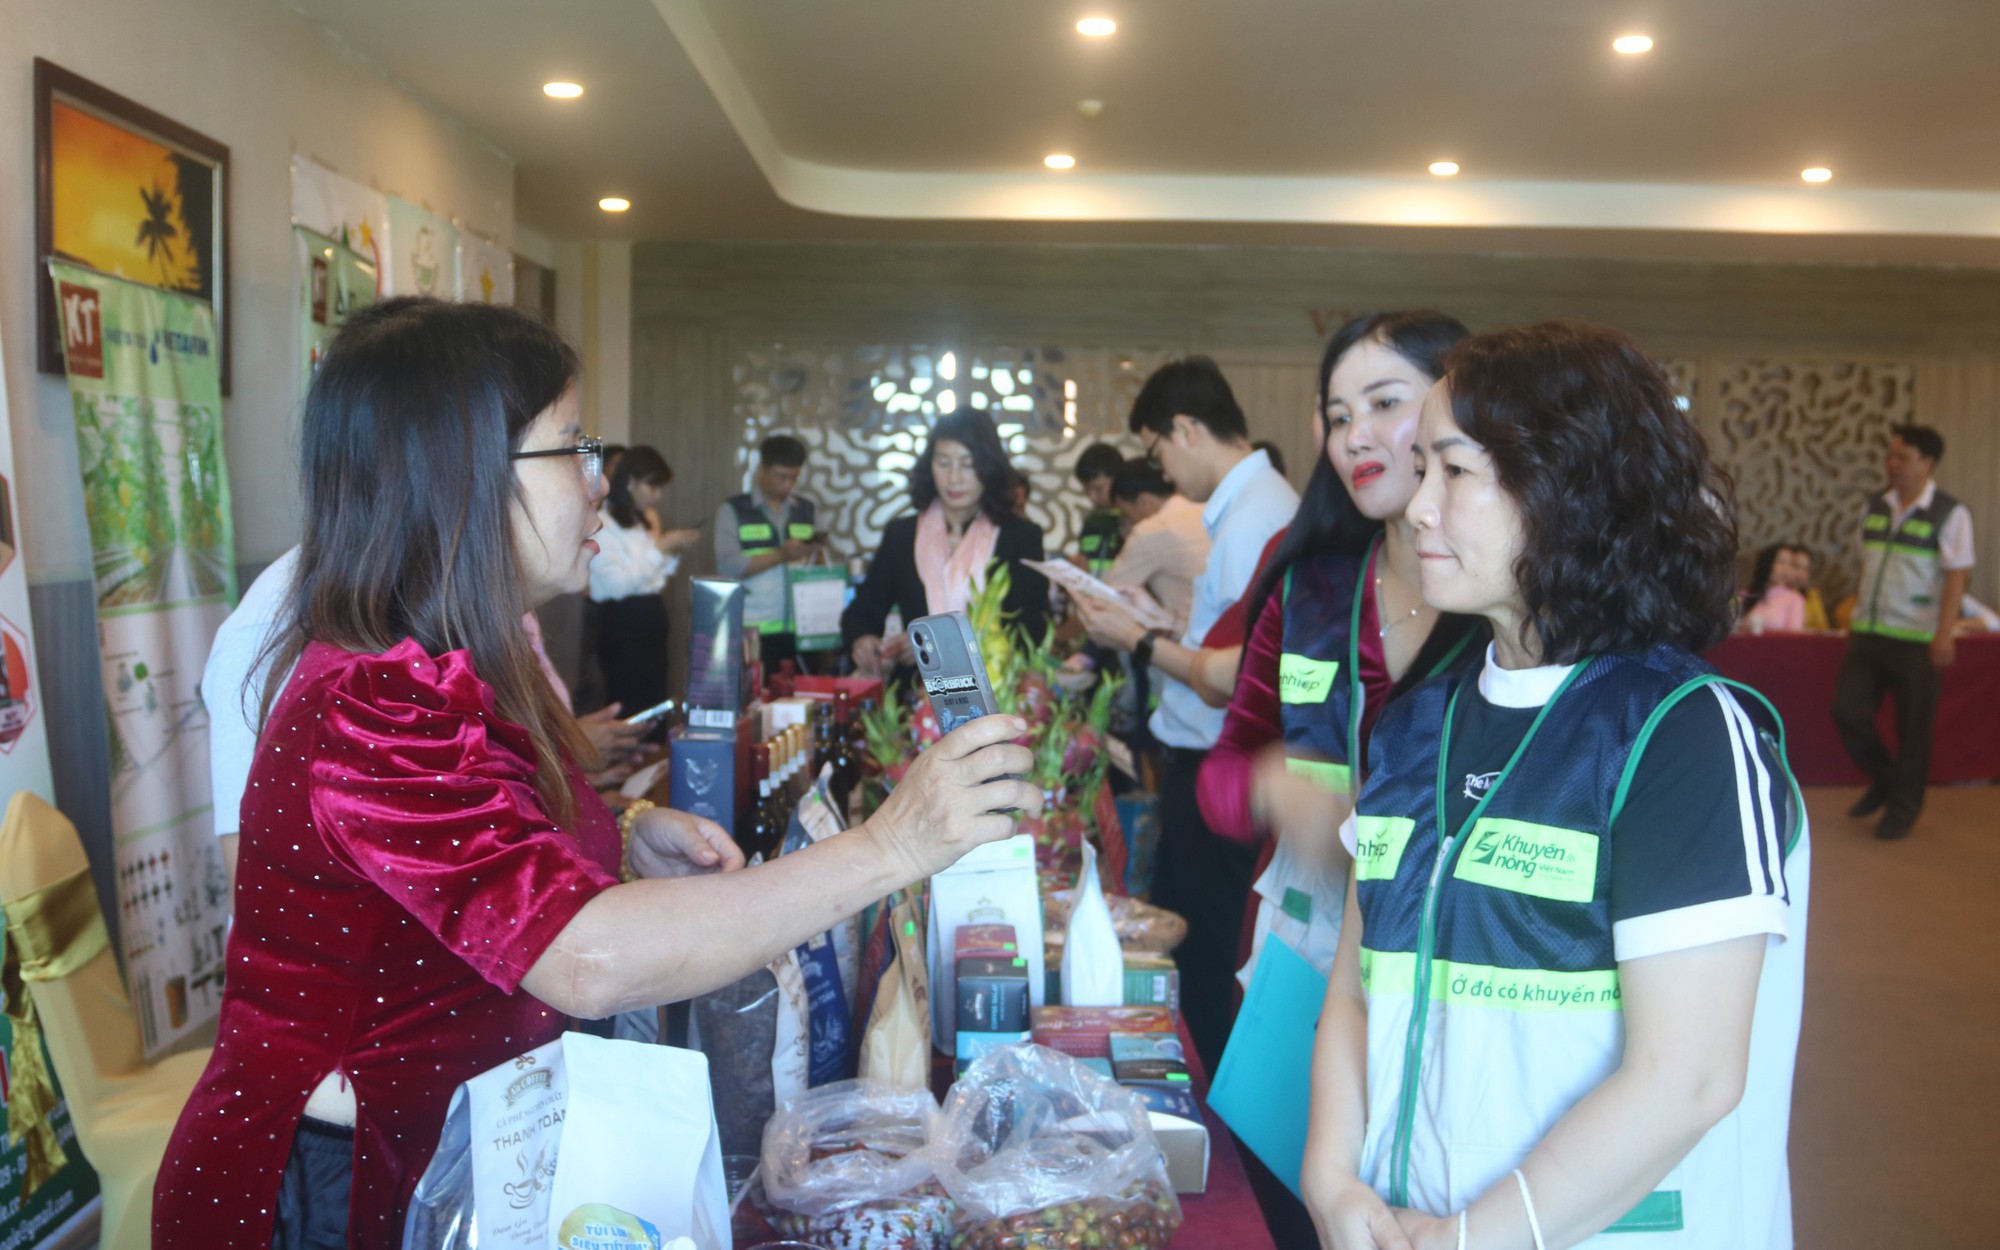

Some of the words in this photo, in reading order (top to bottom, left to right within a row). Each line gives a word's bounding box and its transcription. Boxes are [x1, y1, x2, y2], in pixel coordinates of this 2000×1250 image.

[64, 293, 97, 348] KT
[1451, 974, 1468, 995] Ở
[1470, 980, 1493, 998] đó
[1498, 983, 1518, 1000] có
[1523, 984, 1595, 1006] khuyến
[493, 1124, 535, 1152] THANH
